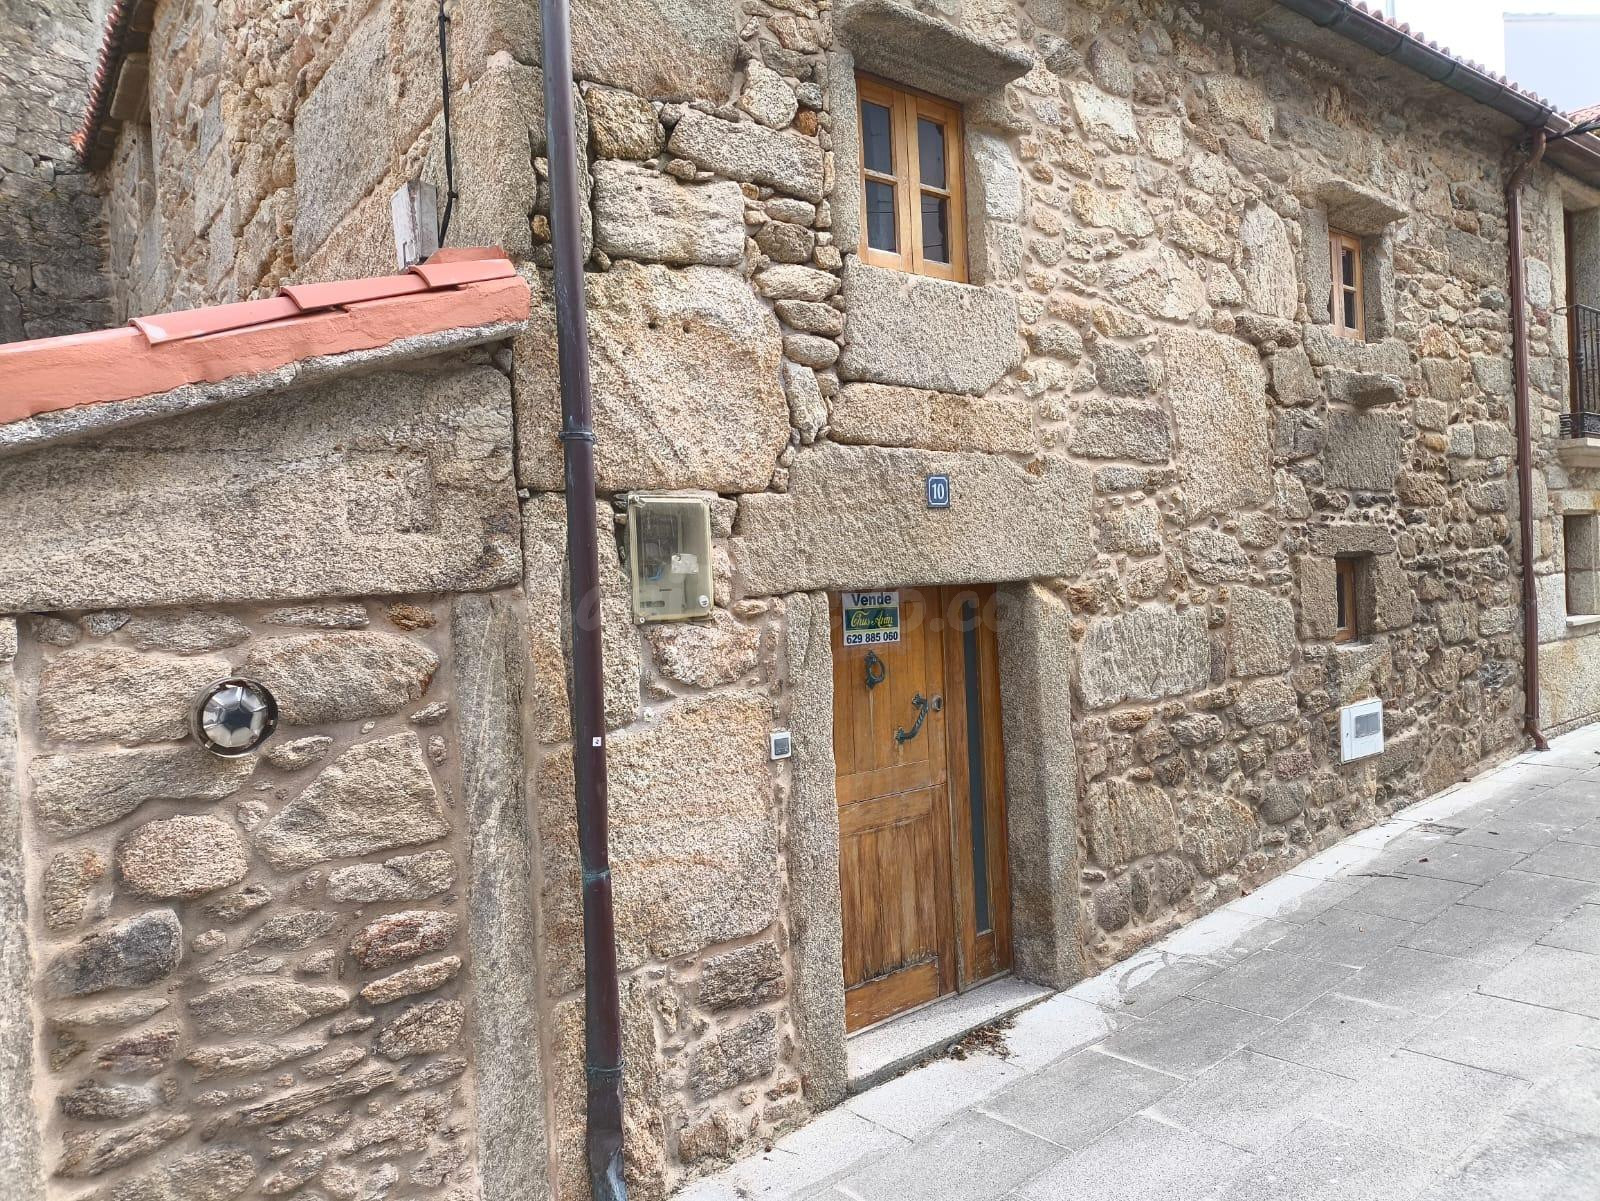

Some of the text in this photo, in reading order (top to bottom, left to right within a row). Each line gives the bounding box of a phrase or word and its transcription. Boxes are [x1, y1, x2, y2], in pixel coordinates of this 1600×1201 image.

[931, 483, 945, 499] 10
[851, 592, 892, 606] Vende
[846, 631, 898, 645] 629 885 060
